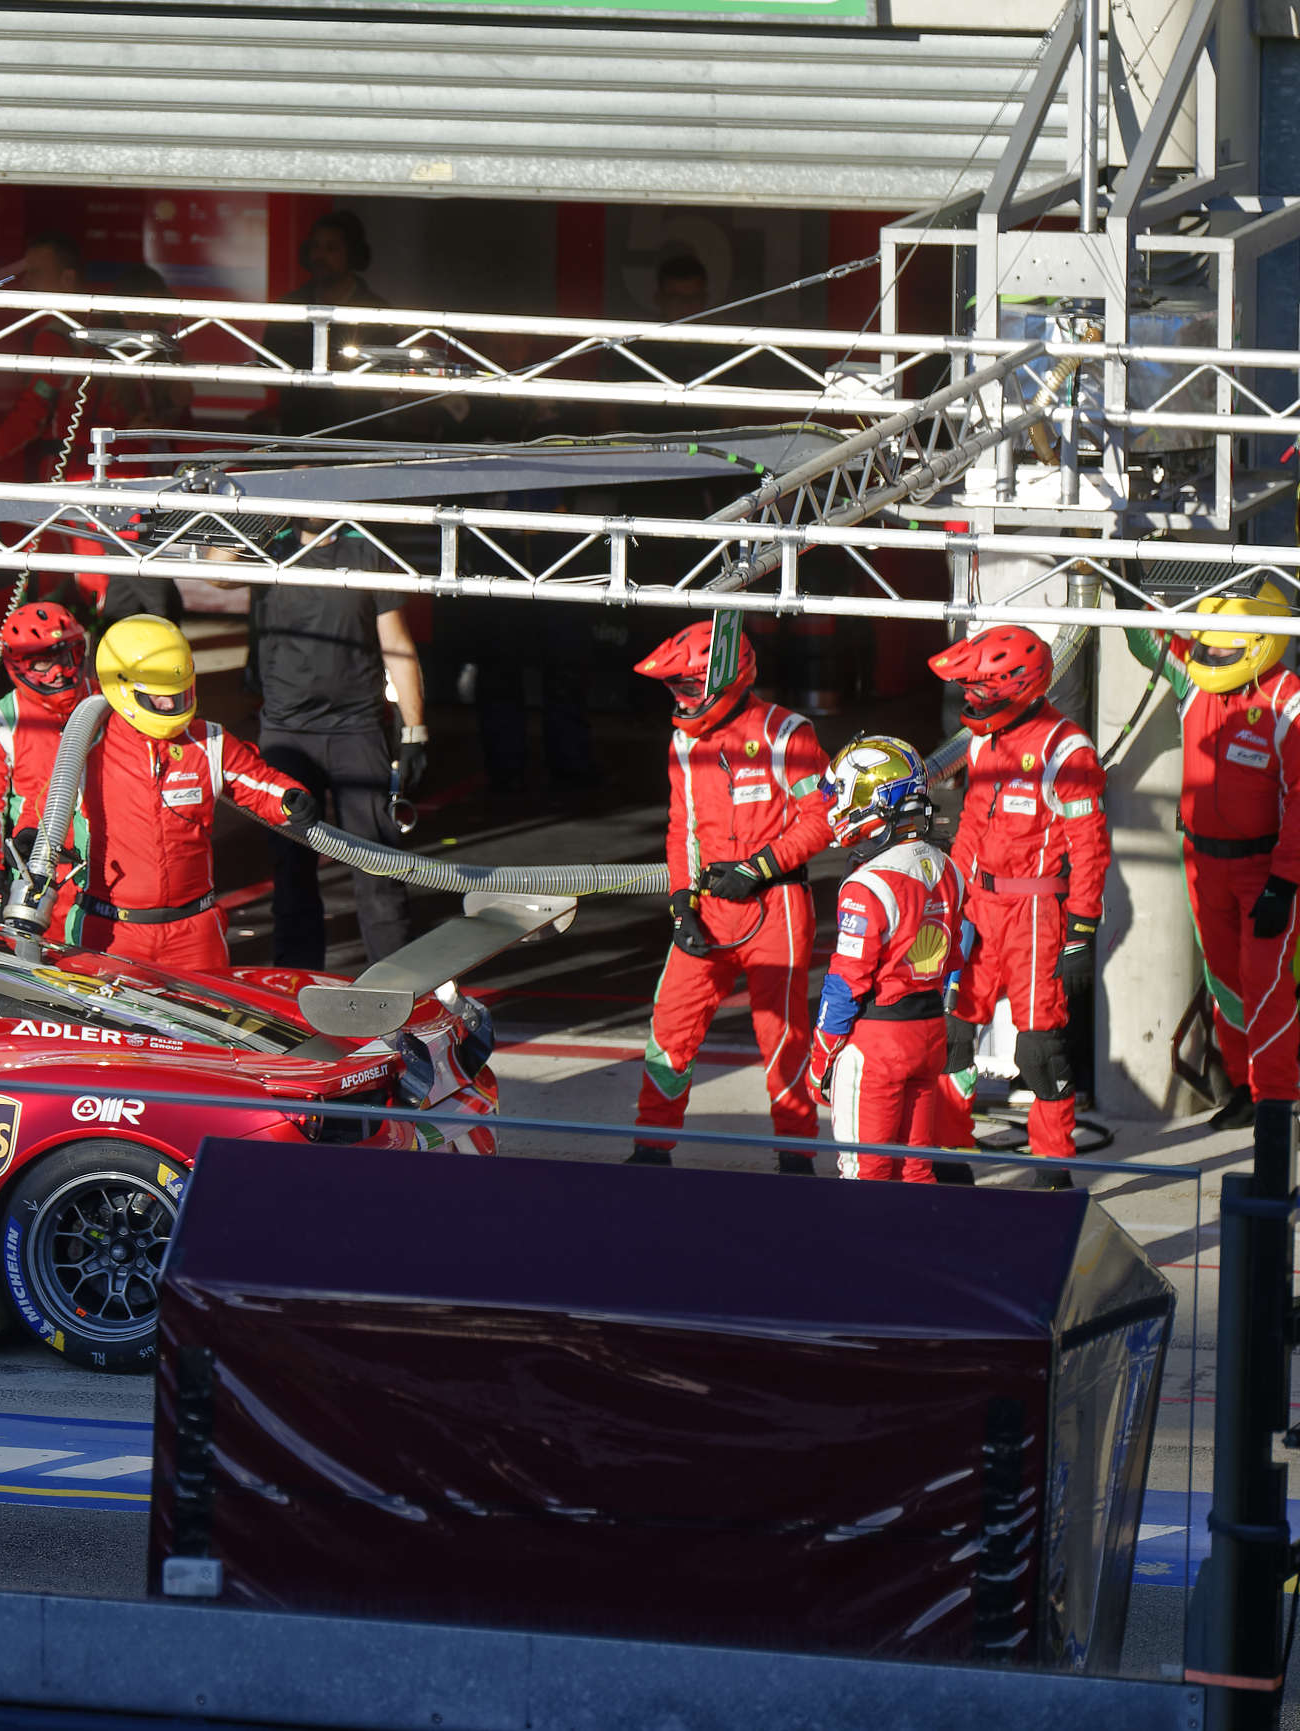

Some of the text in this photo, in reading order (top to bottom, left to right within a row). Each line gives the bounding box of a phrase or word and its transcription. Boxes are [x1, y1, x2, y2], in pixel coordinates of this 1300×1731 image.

[712, 610, 740, 689] 51
[10, 1020, 122, 1045] ADLER
[150, 1037, 183, 1046] PELZER
[149, 1043, 183, 1051] GROUP
[341, 1064, 388, 1089] AFCORSE.IT
[6, 1227, 40, 1323] MICHELIN
